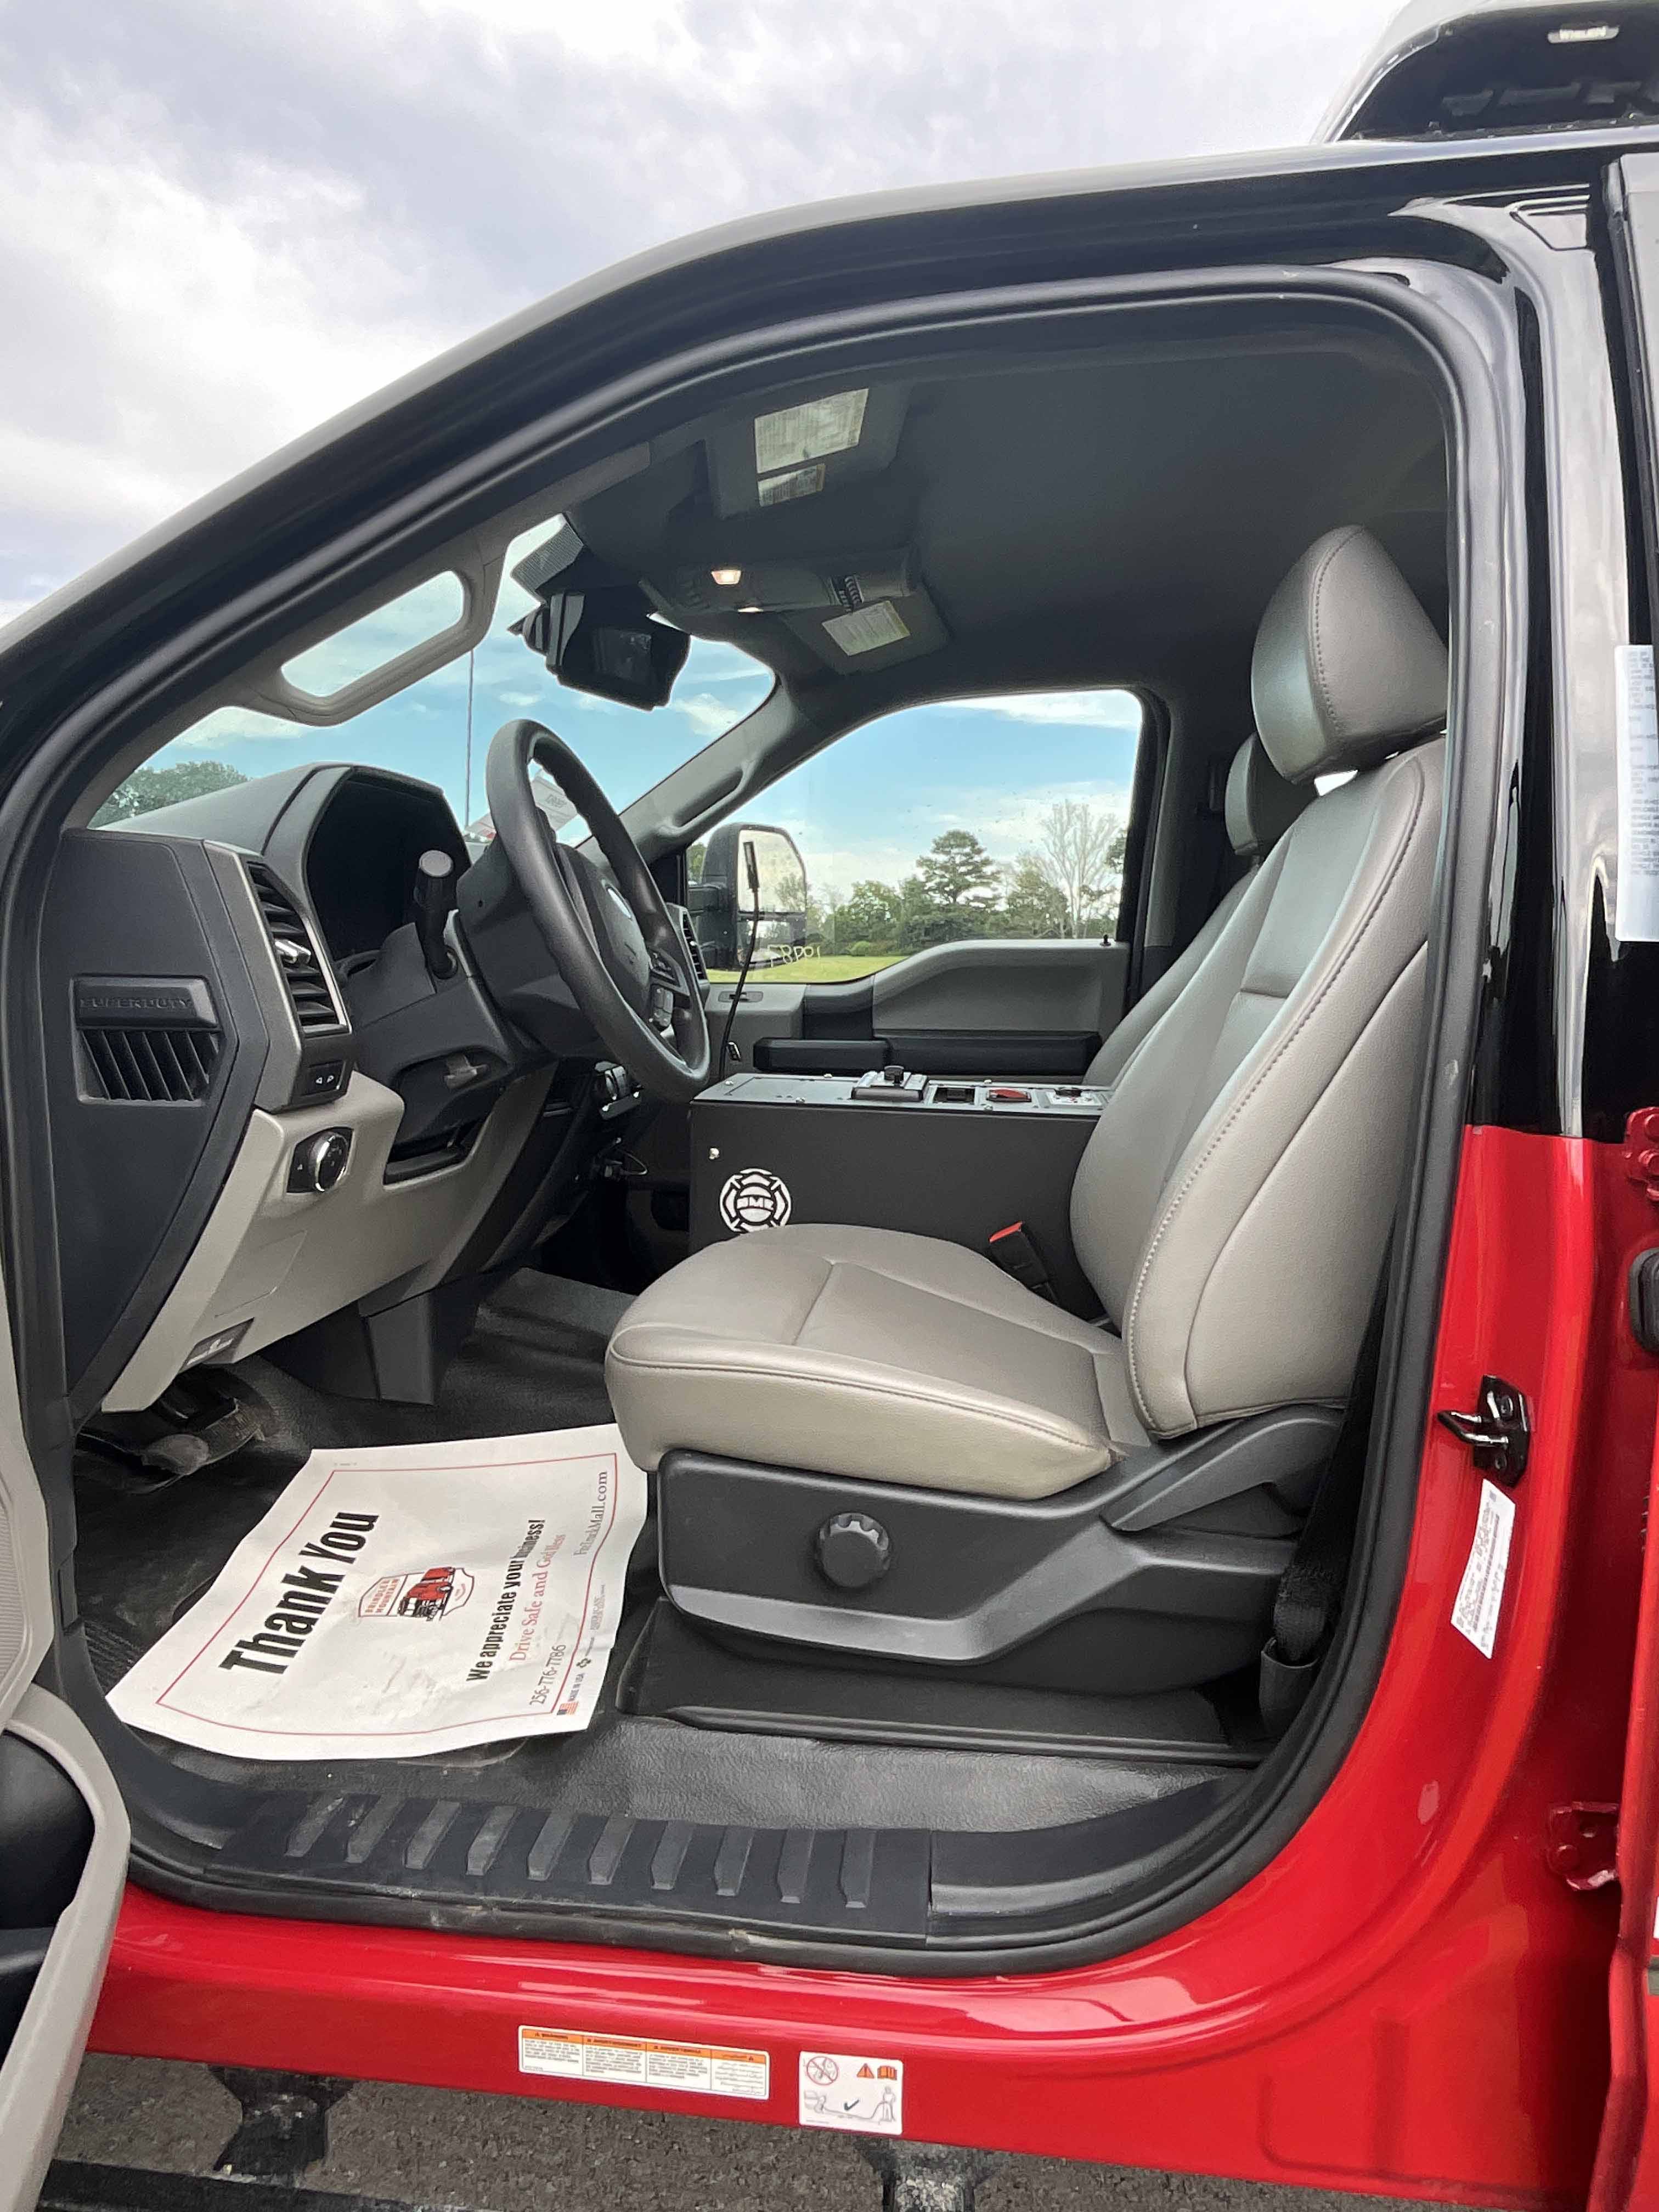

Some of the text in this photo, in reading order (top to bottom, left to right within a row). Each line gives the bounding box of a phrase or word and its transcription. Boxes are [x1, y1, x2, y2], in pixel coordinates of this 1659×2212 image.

[218, 1511, 379, 1674] Thank You
[532, 1571, 548, 1597] and
[466, 1660, 492, 1681] We
[480, 1591, 517, 1658] appreciate
[503, 1560, 525, 1589] your
[522, 1600, 543, 1625] Safe
[510, 1628, 534, 1661] Drive
[529, 1645, 566, 1706] 256-776-7786
